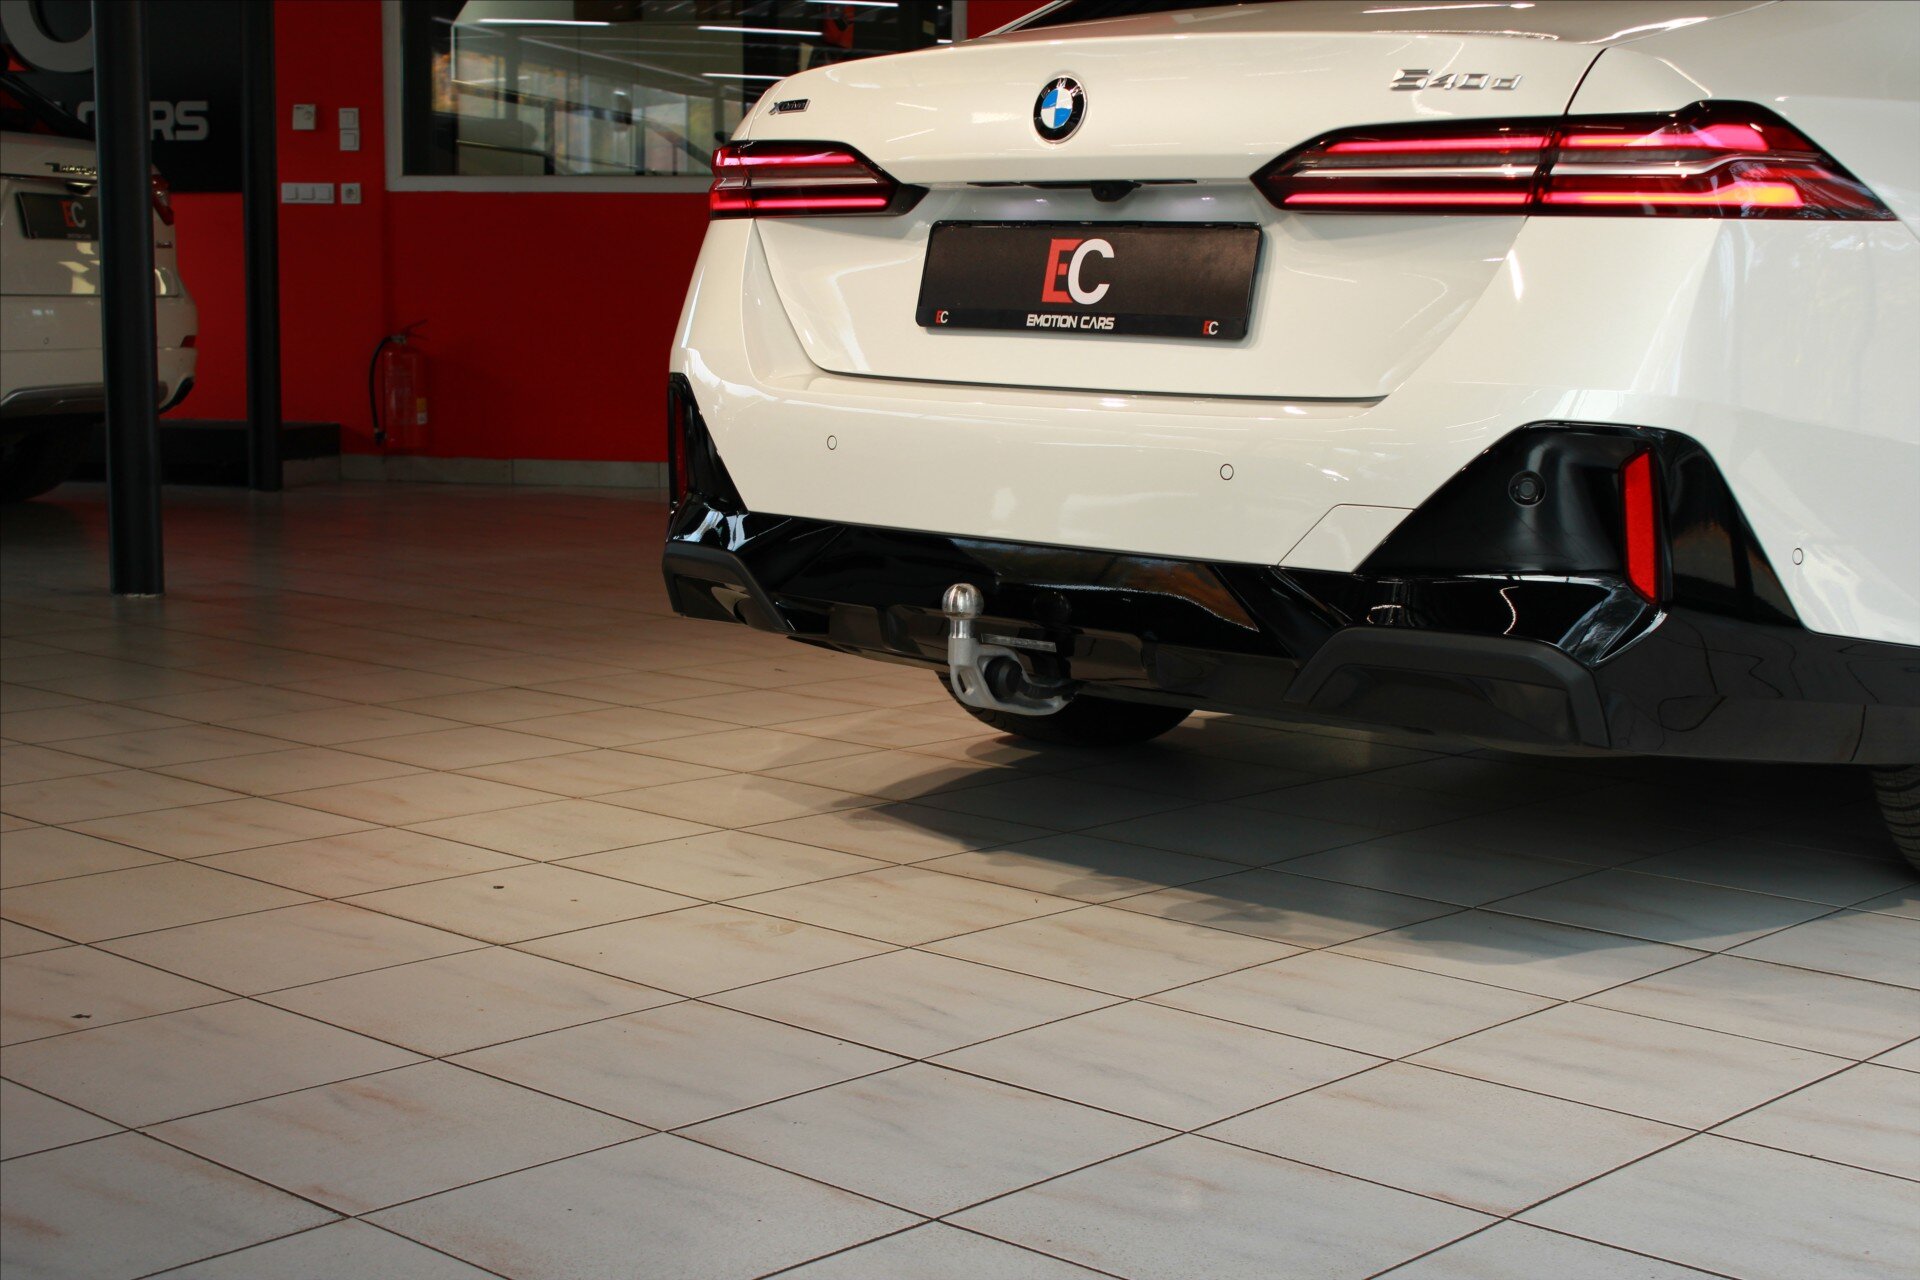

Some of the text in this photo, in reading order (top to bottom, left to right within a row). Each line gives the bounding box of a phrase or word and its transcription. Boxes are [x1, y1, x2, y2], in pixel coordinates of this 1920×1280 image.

[1041, 77, 1083, 99] BMW
[1389, 69, 1522, 91] 540d
[62, 200, 86, 228] EC
[1042, 238, 1115, 305] EC
[935, 309, 949, 323] EC
[1026, 314, 1115, 330] EMOTION CARS
[1203, 320, 1219, 335] EC
